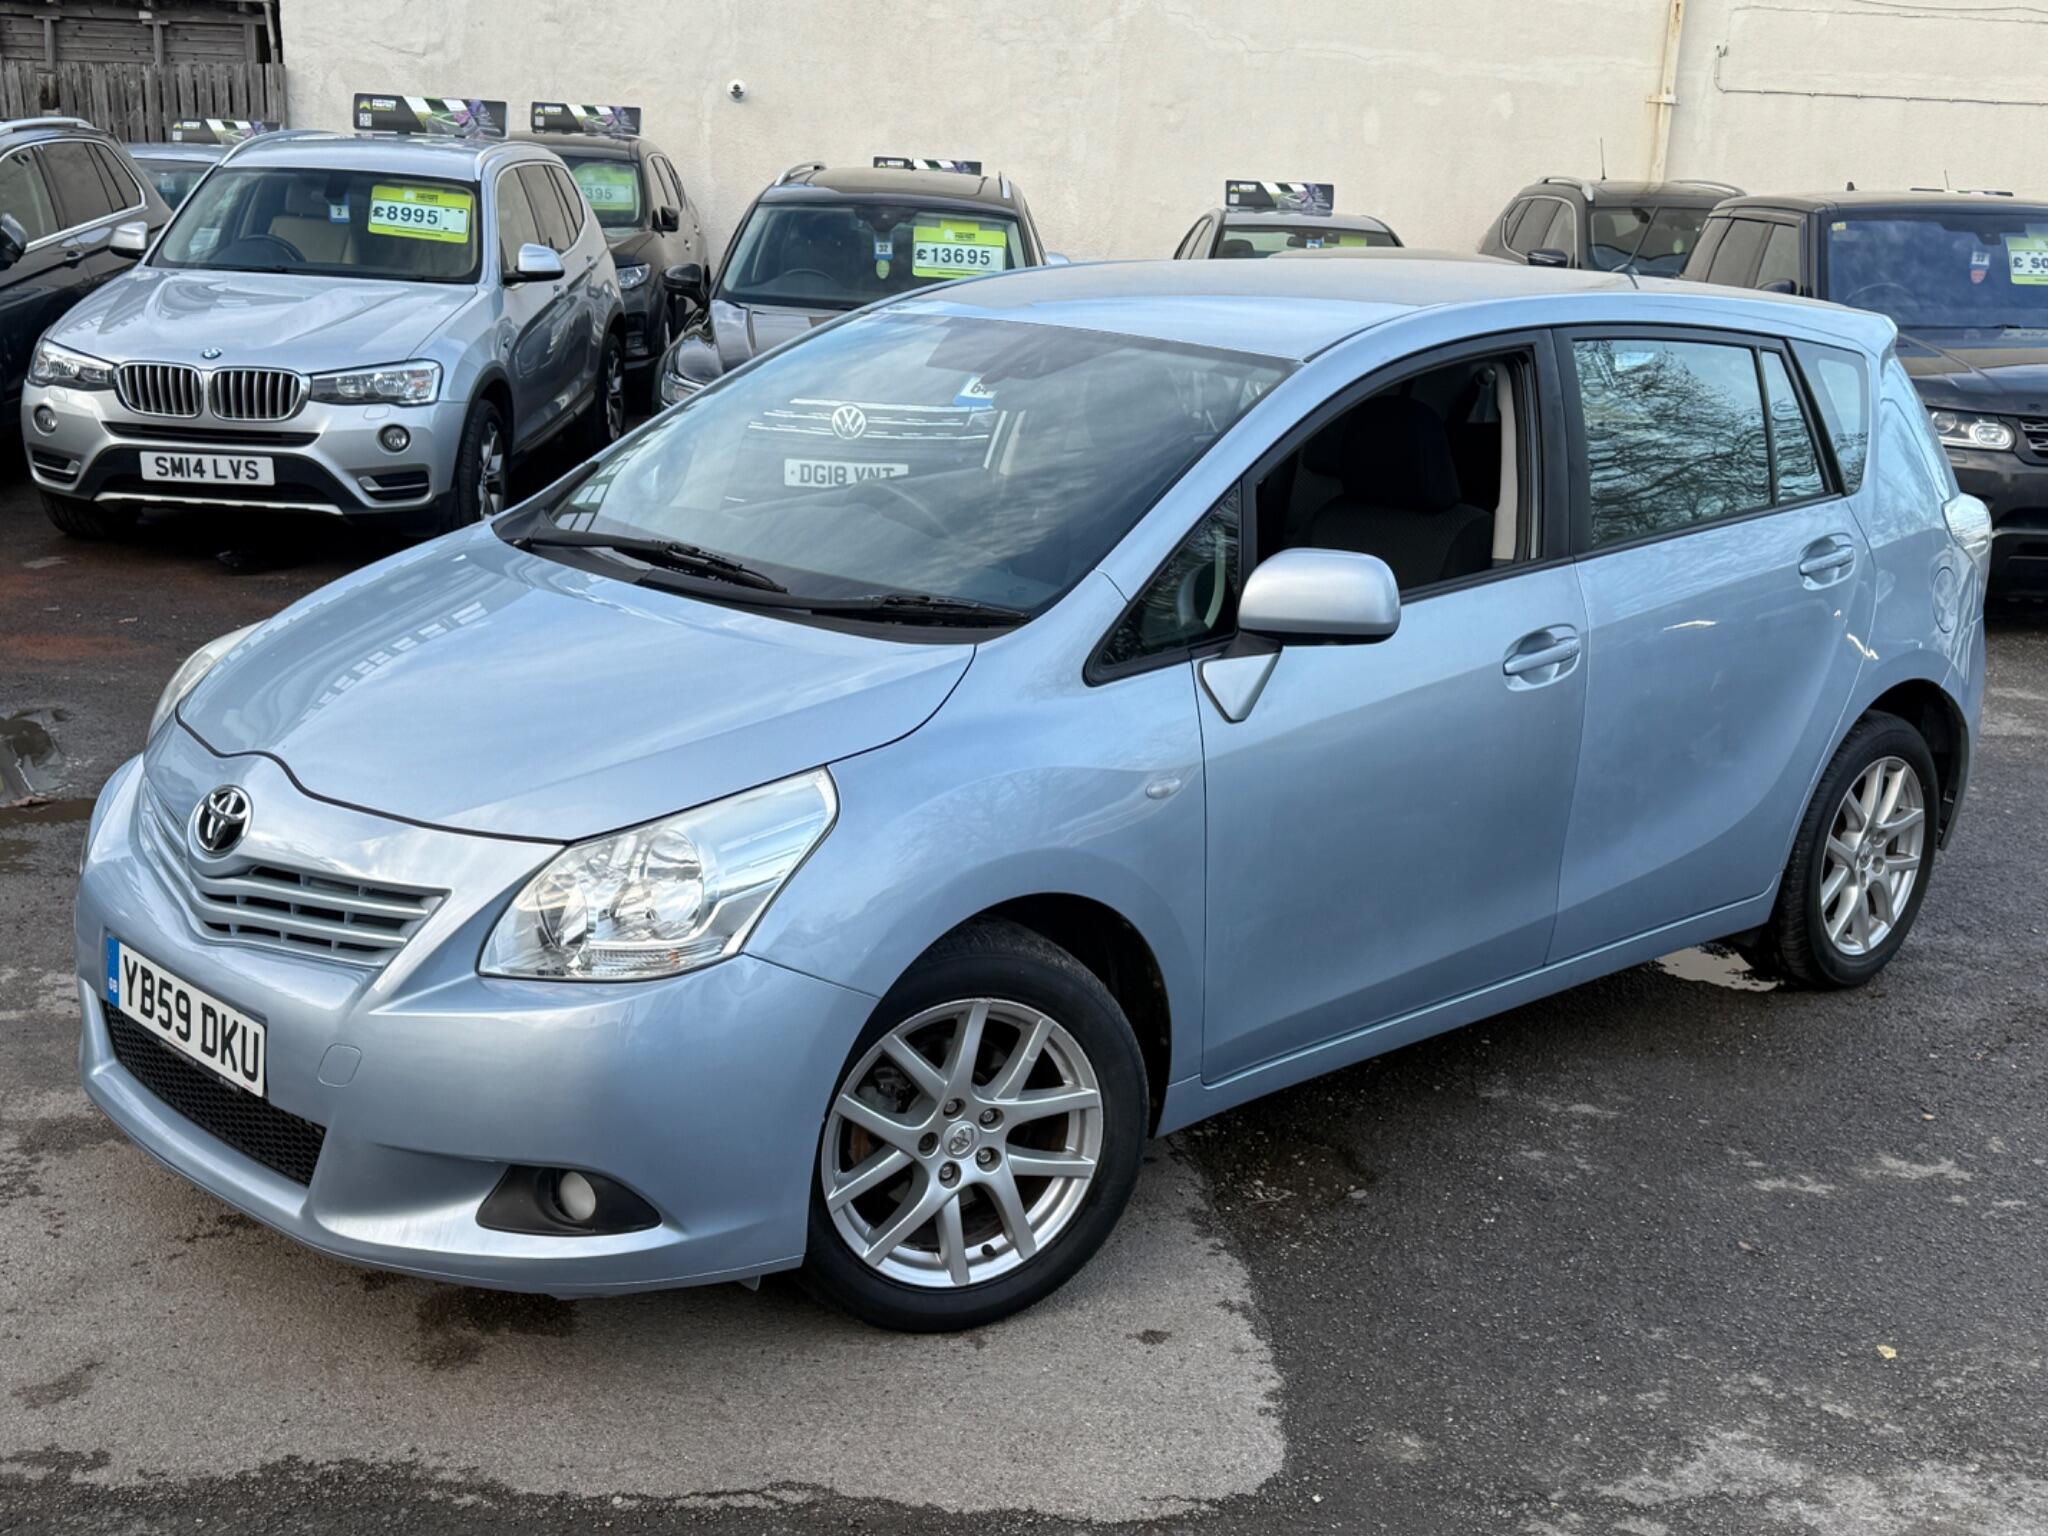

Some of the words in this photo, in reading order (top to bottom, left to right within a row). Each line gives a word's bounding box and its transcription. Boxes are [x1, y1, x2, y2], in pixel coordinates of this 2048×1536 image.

[580, 186, 613, 200] 395
[373, 205, 439, 225] £8995
[916, 247, 991, 266] £13695
[2013, 256, 2024, 268] £
[154, 456, 207, 479] SM14
[212, 458, 260, 481] LVS
[799, 463, 848, 486] DG18
[123, 954, 192, 1043] YB59
[200, 1001, 260, 1083] DKU
